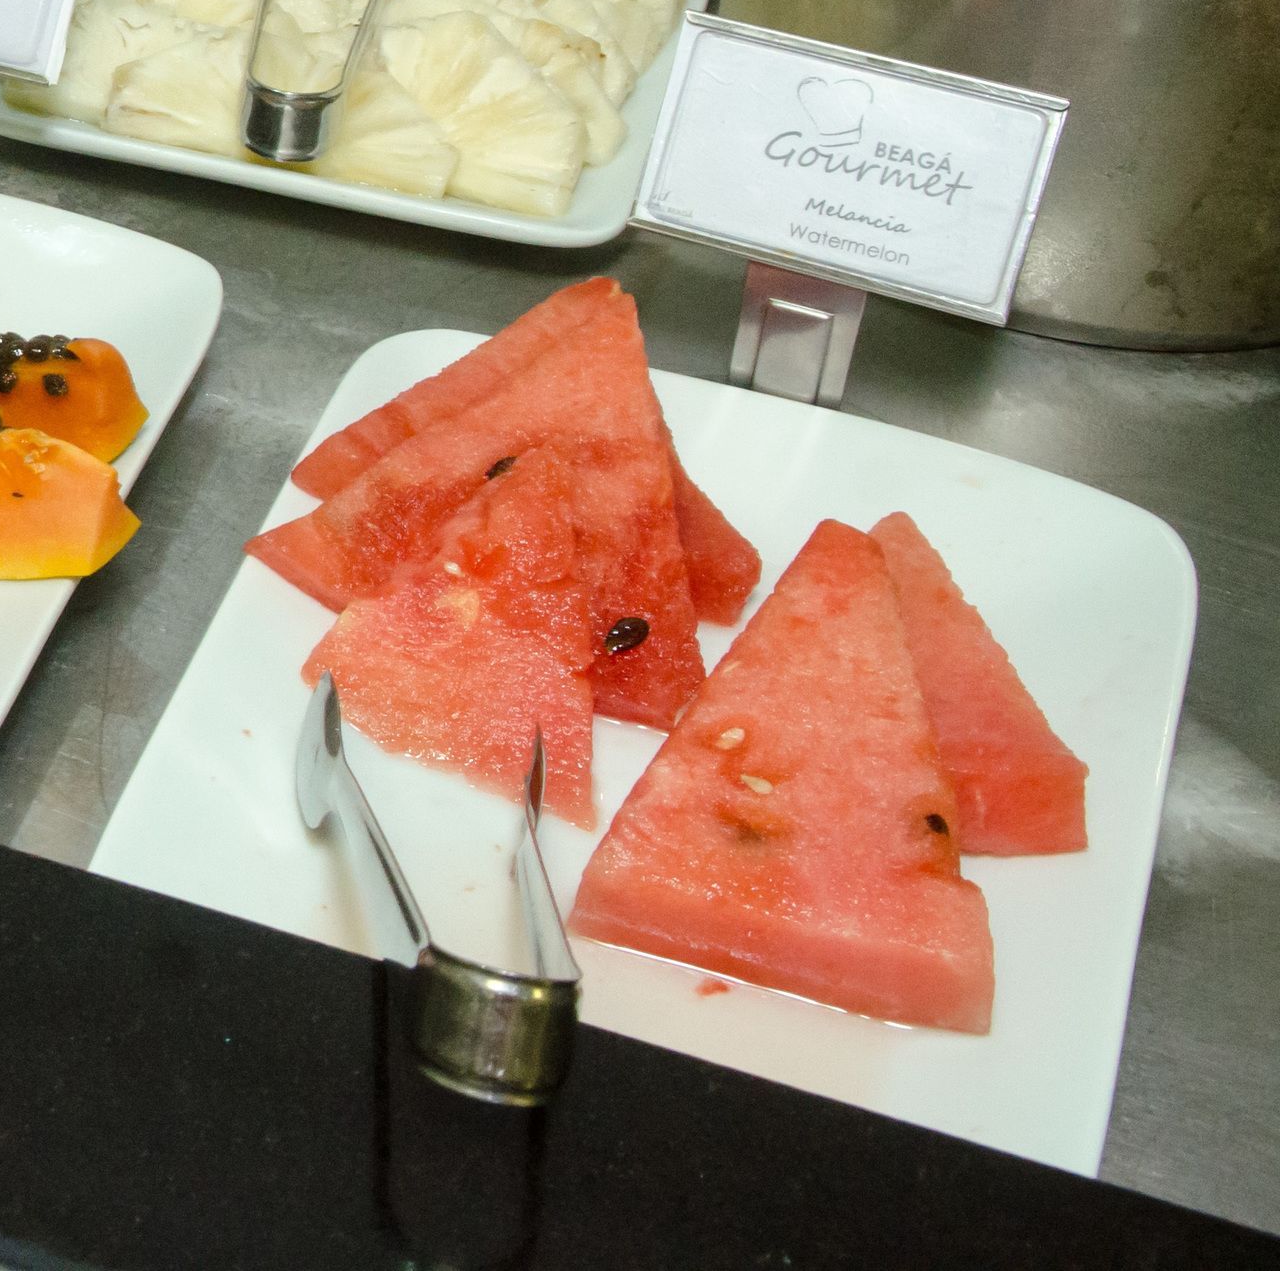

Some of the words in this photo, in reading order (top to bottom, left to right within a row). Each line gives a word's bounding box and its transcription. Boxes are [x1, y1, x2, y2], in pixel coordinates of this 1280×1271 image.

[764, 131, 974, 206] Gourmet
[874, 141, 952, 175] BEAGÁ
[805, 196, 912, 234] Melancia
[789, 222, 910, 265] Watermelon
